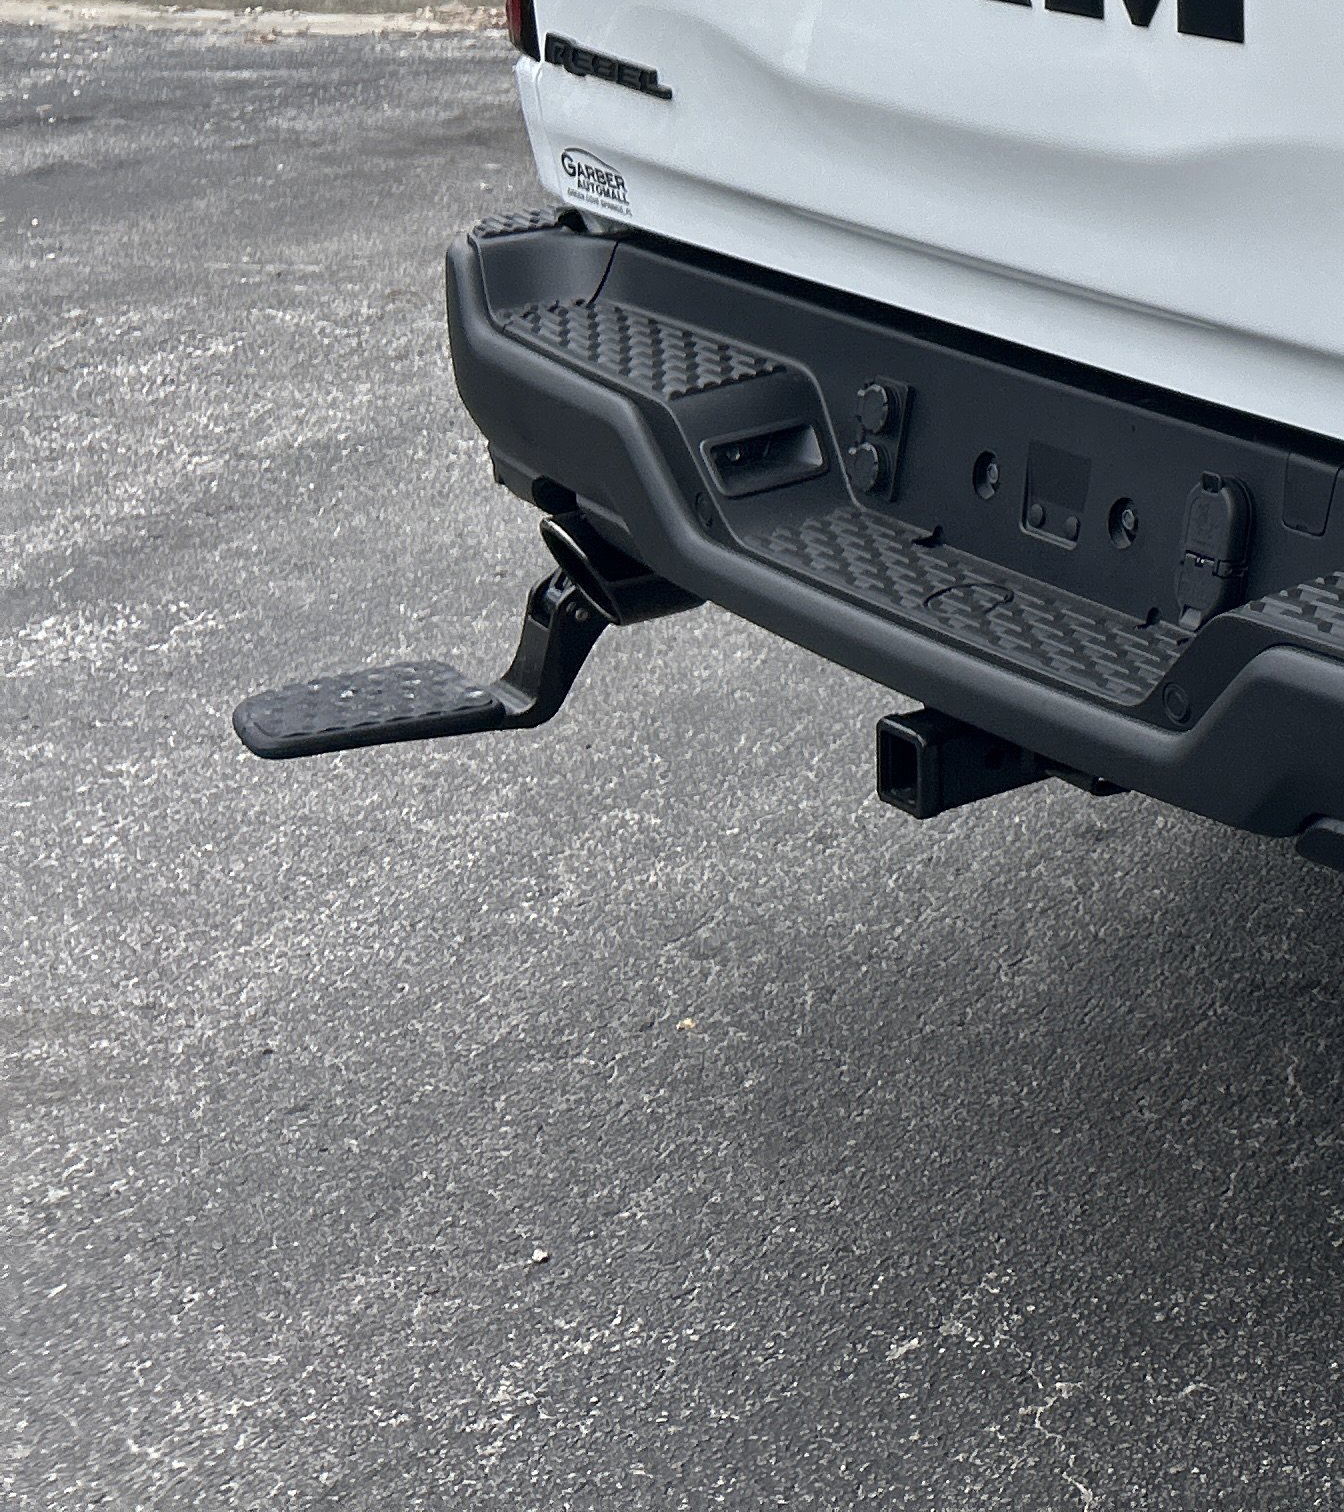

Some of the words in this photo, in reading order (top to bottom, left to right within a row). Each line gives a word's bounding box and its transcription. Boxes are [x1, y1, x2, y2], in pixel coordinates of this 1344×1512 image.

[545, 32, 673, 100] REBEL
[561, 151, 628, 193] GARBER
[577, 178, 630, 206] AUTOMALL
